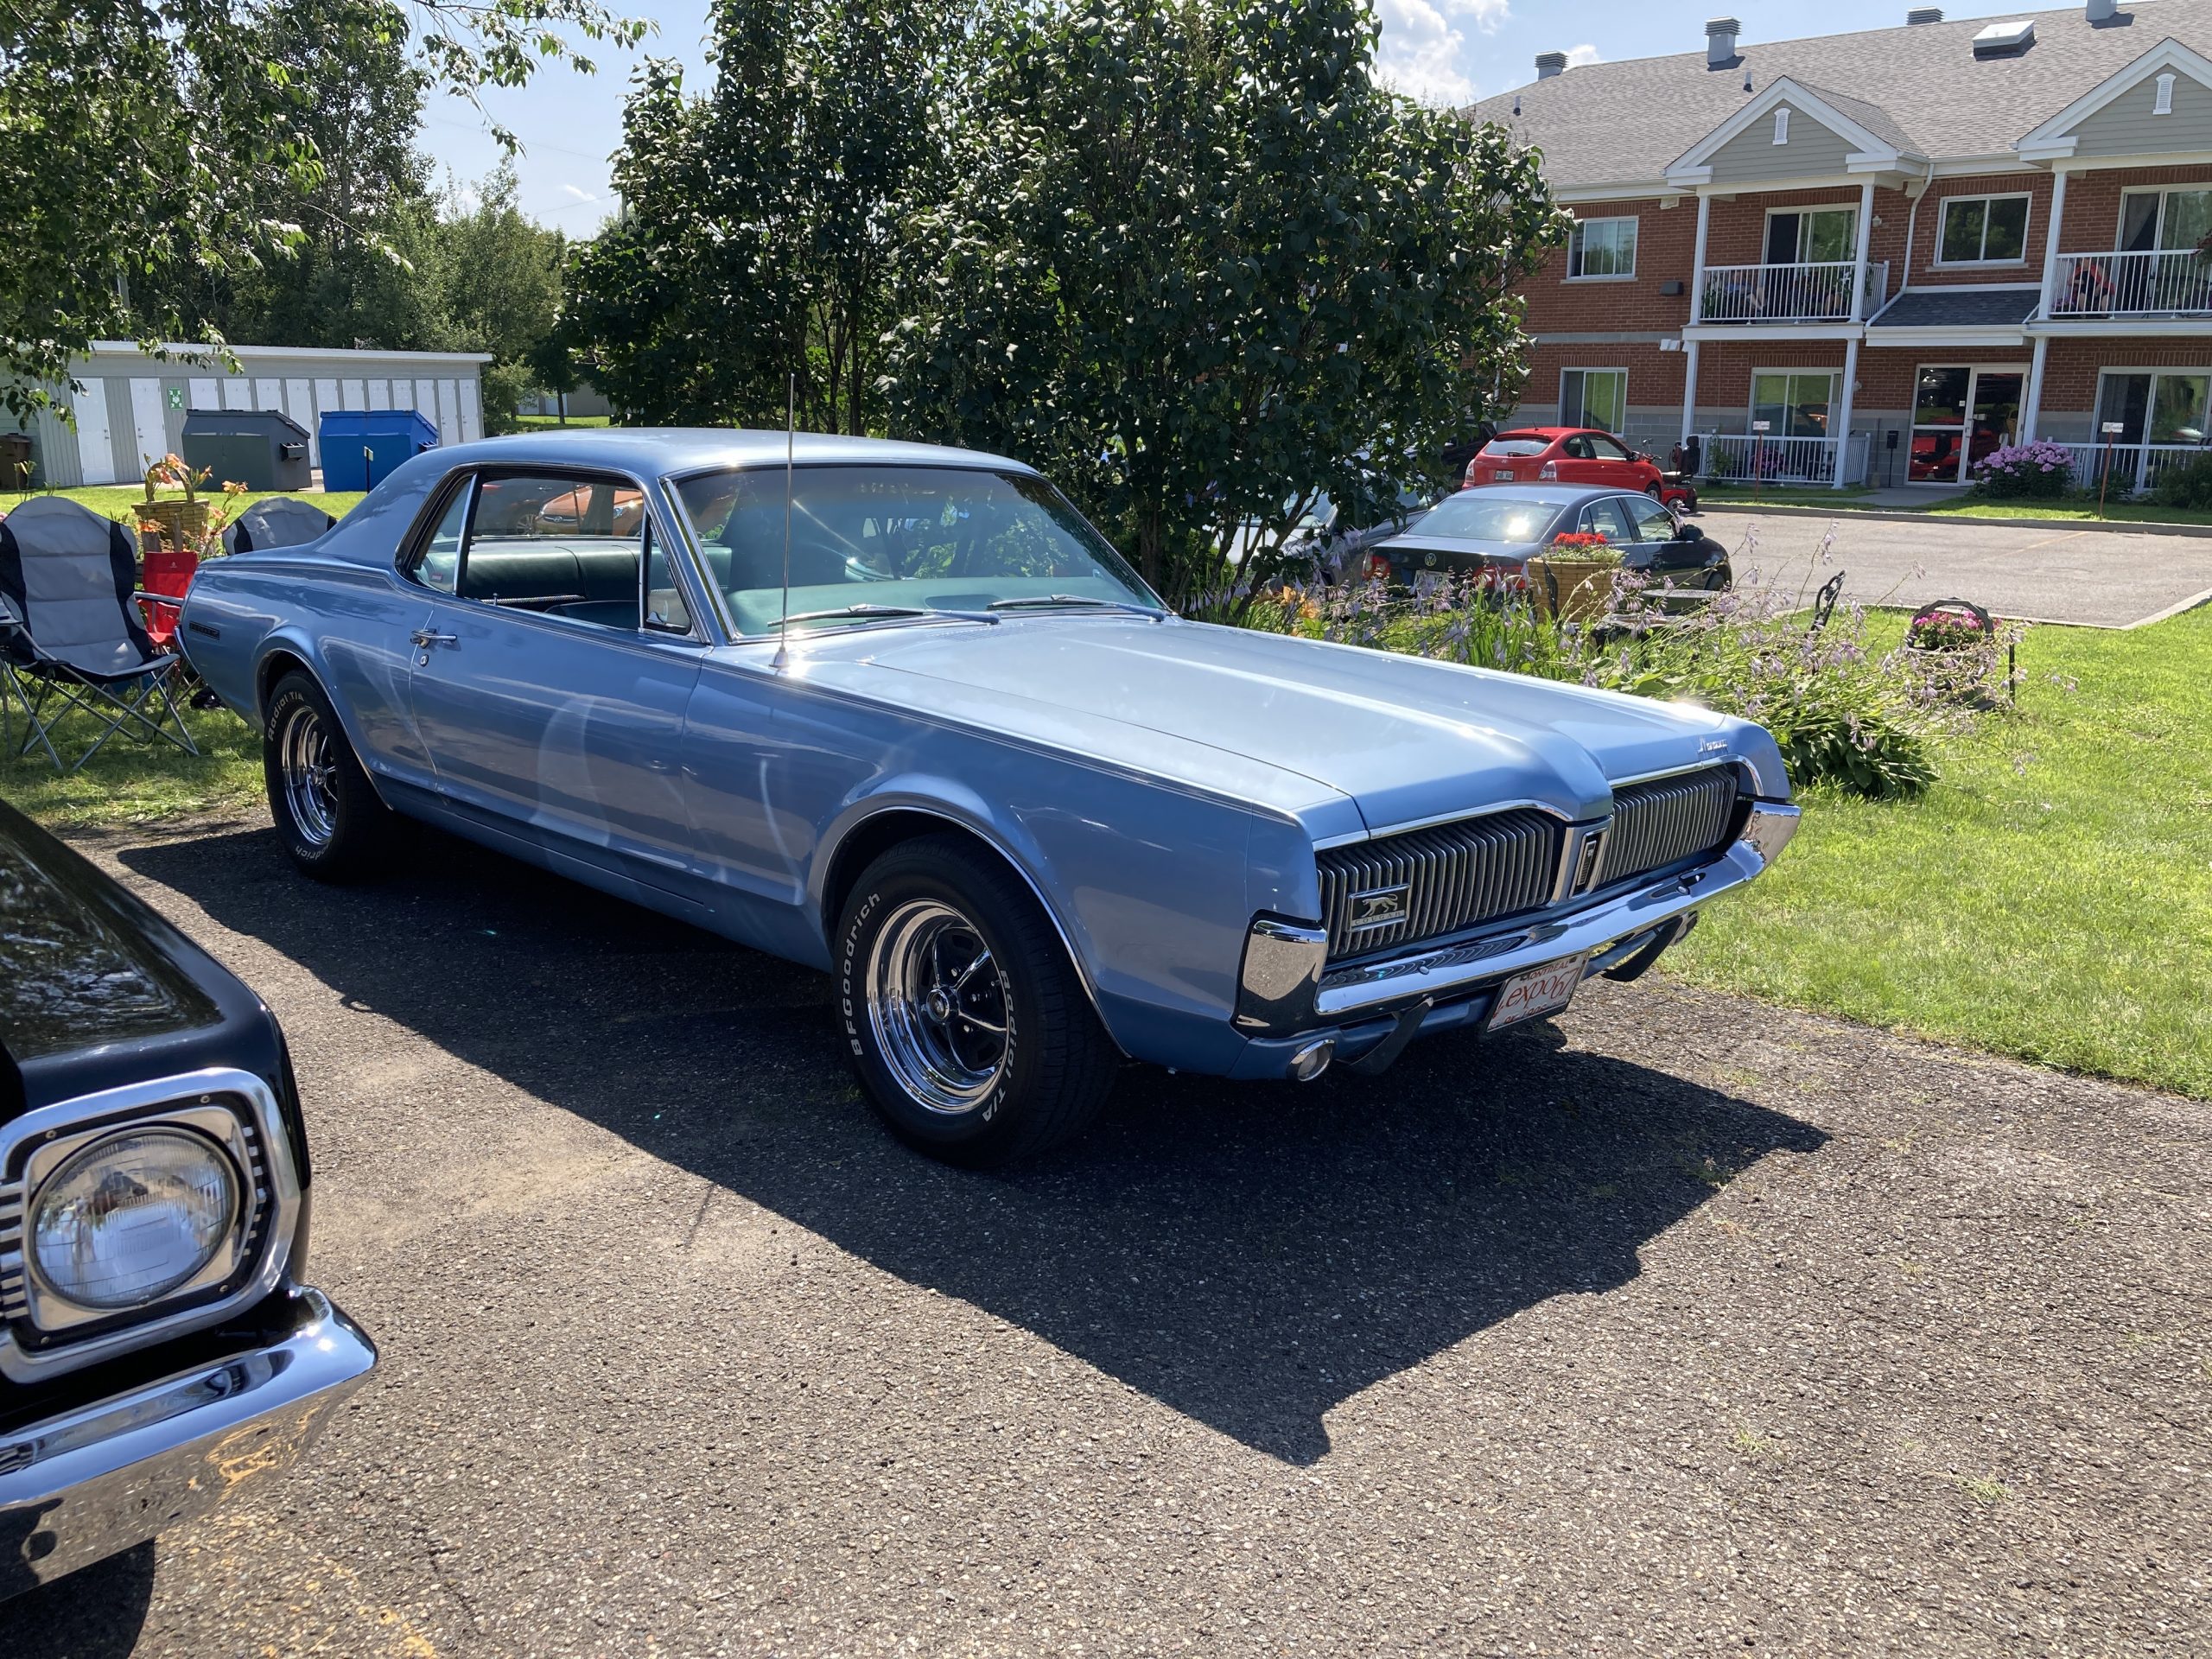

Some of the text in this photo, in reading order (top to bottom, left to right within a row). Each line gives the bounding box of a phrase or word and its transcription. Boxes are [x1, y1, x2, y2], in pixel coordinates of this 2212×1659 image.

[268, 694, 289, 741] Radial
[1354, 912, 1402, 925] COUGAR
[842, 893, 880, 1056] BFGoodrich
[982, 970, 1017, 1122] Radial T/A
